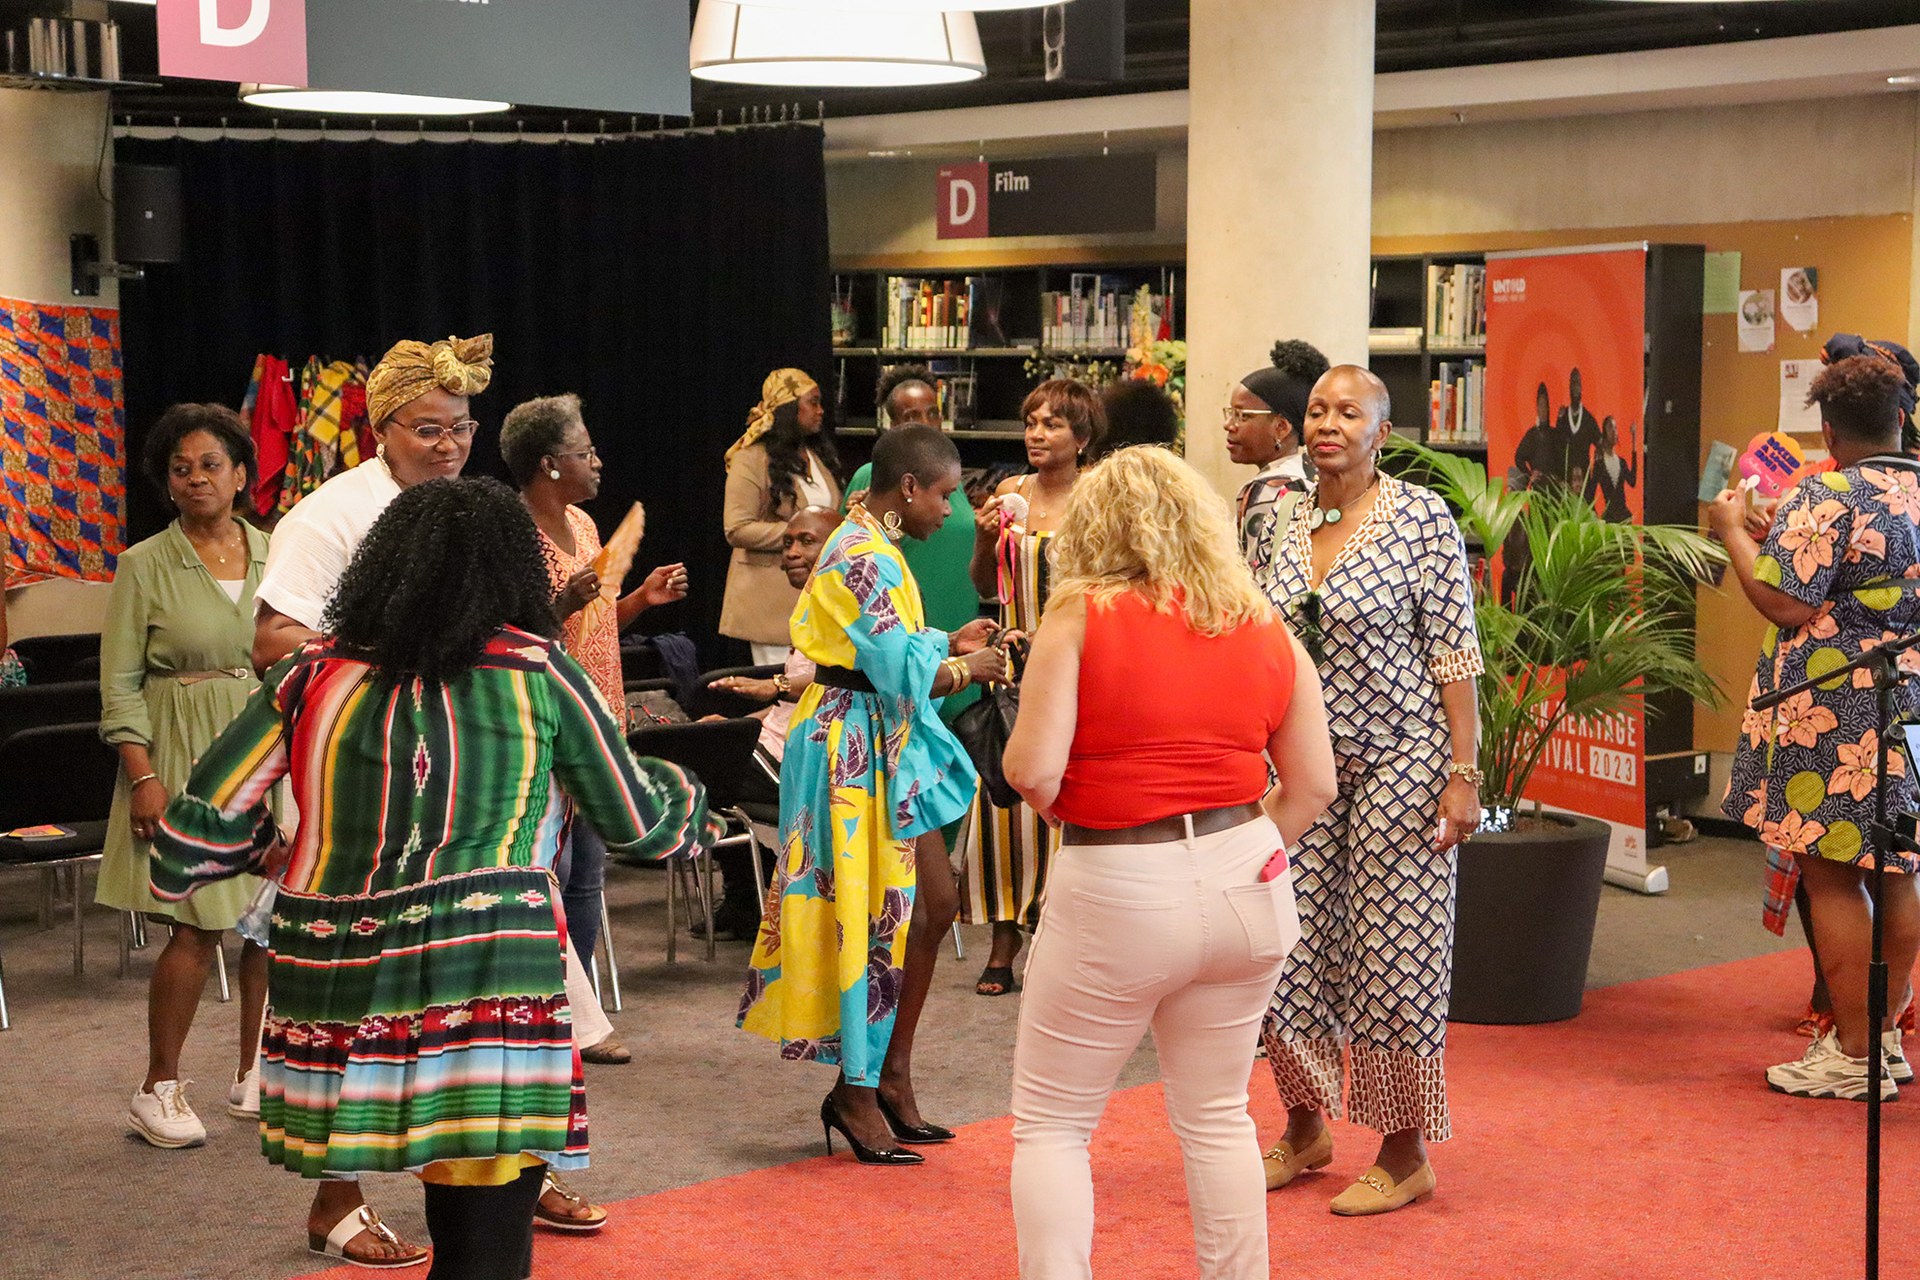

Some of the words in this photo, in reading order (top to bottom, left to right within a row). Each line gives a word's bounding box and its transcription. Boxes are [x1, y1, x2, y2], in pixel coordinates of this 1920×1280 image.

[198, 0, 271, 47] D
[949, 179, 977, 225] D
[994, 171, 1029, 192] Film
[1592, 750, 1634, 783] 2023
